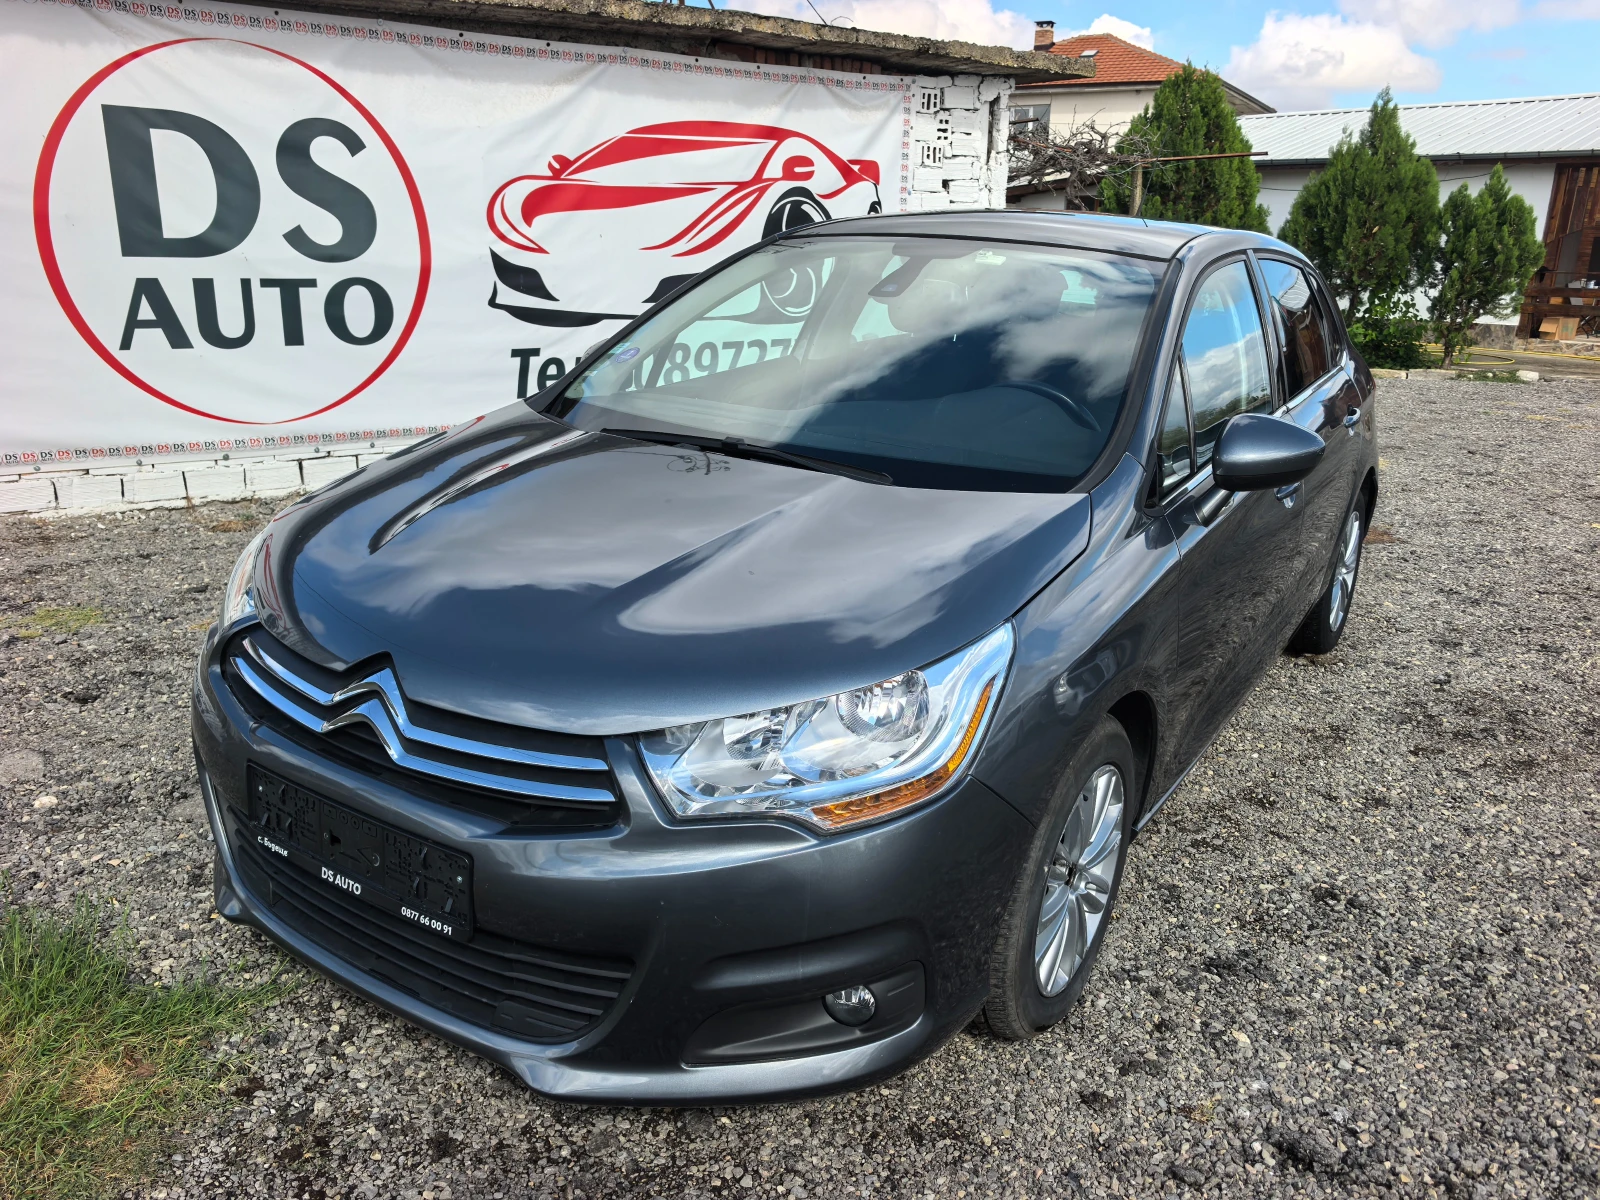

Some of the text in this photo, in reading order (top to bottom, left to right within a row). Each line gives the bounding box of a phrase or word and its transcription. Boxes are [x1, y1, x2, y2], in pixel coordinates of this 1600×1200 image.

[101, 104, 377, 262] DS
[119, 276, 394, 350] AUTO
[511, 348, 583, 399] Те
[321, 867, 361, 895] DS AUTO
[401, 907, 452, 935] 0877 66 00 91
